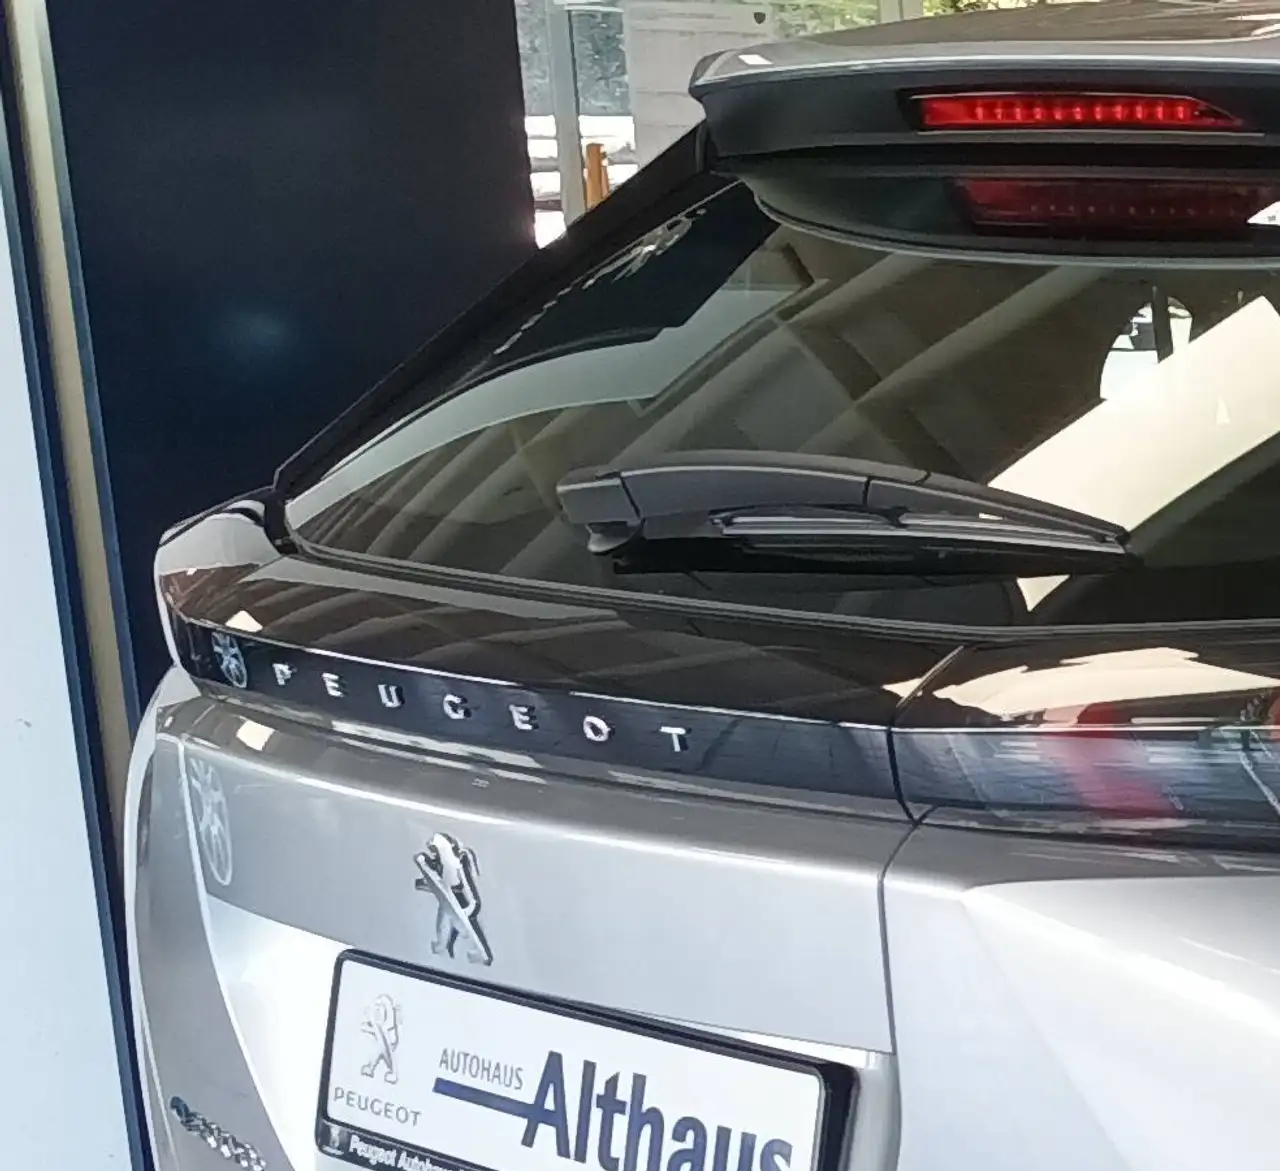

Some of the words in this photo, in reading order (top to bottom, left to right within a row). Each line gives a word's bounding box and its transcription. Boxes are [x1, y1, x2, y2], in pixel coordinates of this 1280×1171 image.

[272, 662, 692, 753] PEUGEOT
[439, 1048, 524, 1091] AUTOHAUS
[334, 1086, 422, 1127] PEUGEOT
[349, 1134, 397, 1166] Peugeot
